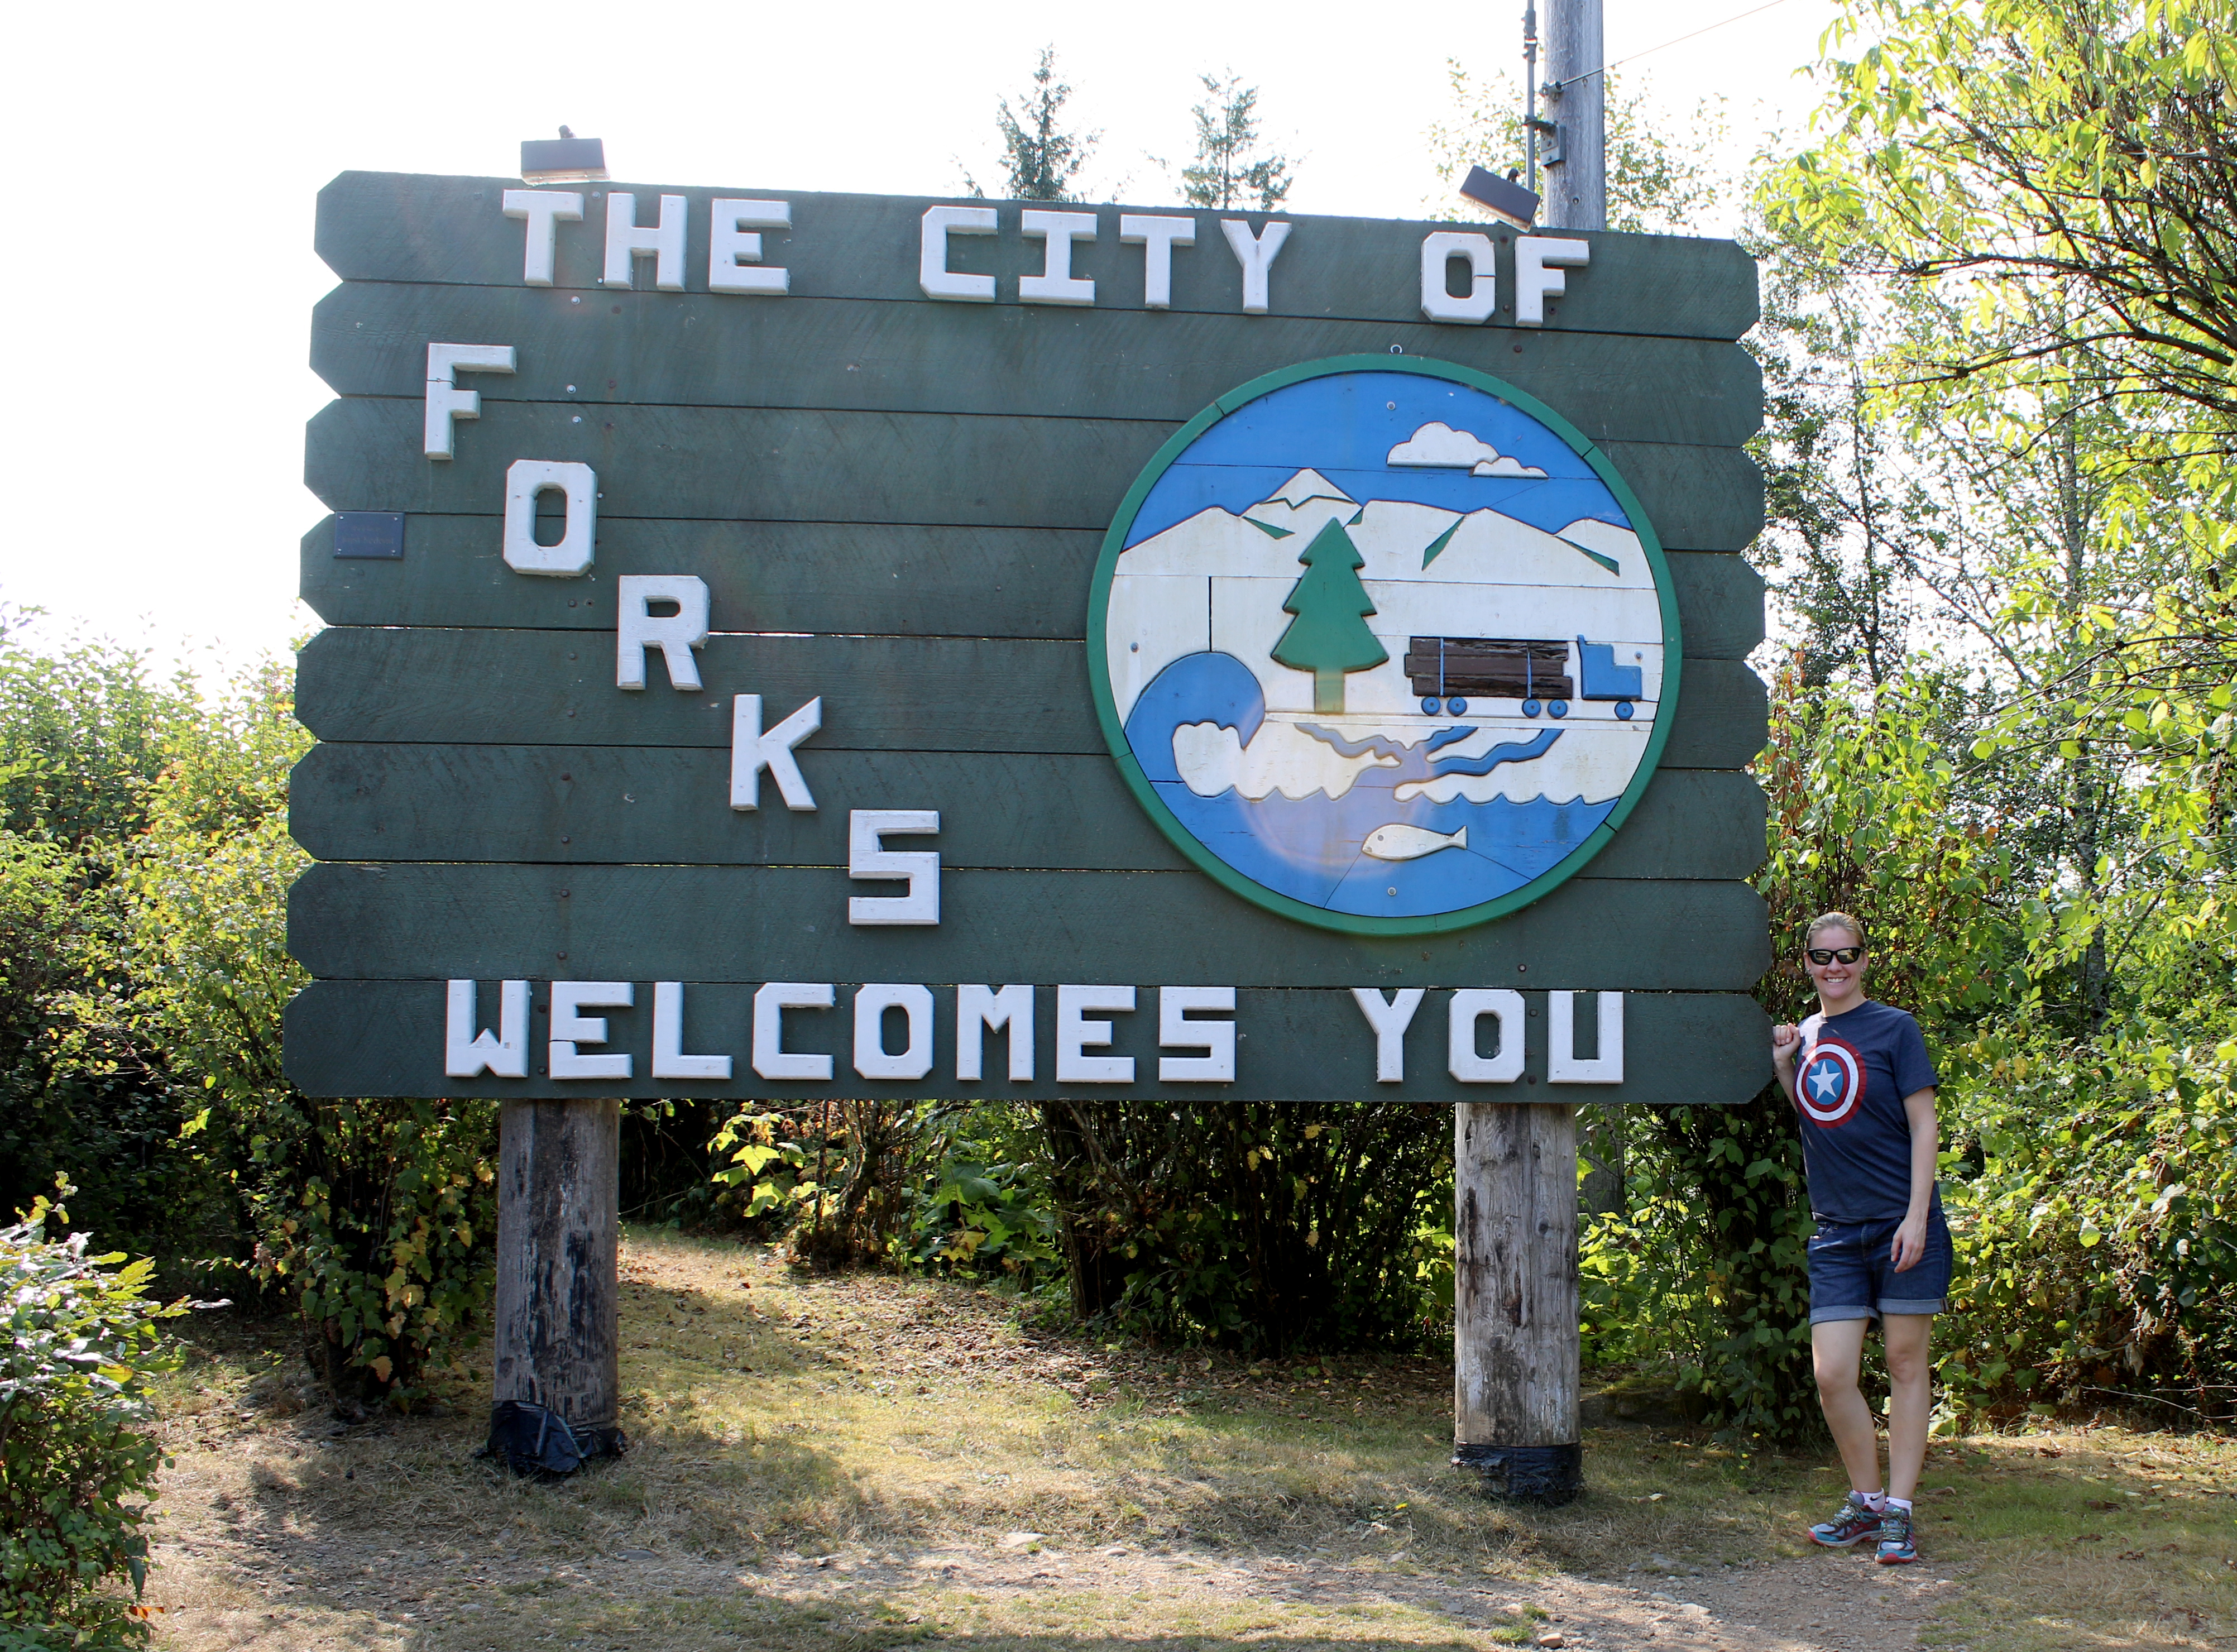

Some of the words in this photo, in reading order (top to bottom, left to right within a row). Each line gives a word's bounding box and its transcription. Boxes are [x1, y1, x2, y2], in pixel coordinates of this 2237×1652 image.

[502, 189, 791, 295] THE
[919, 205, 1292, 314] CITY
[1421, 231, 1590, 327] OF
[424, 342, 940, 926] FORKS
[445, 979, 1237, 1084] WELCOMES
[1350, 987, 1625, 1085] YOU
